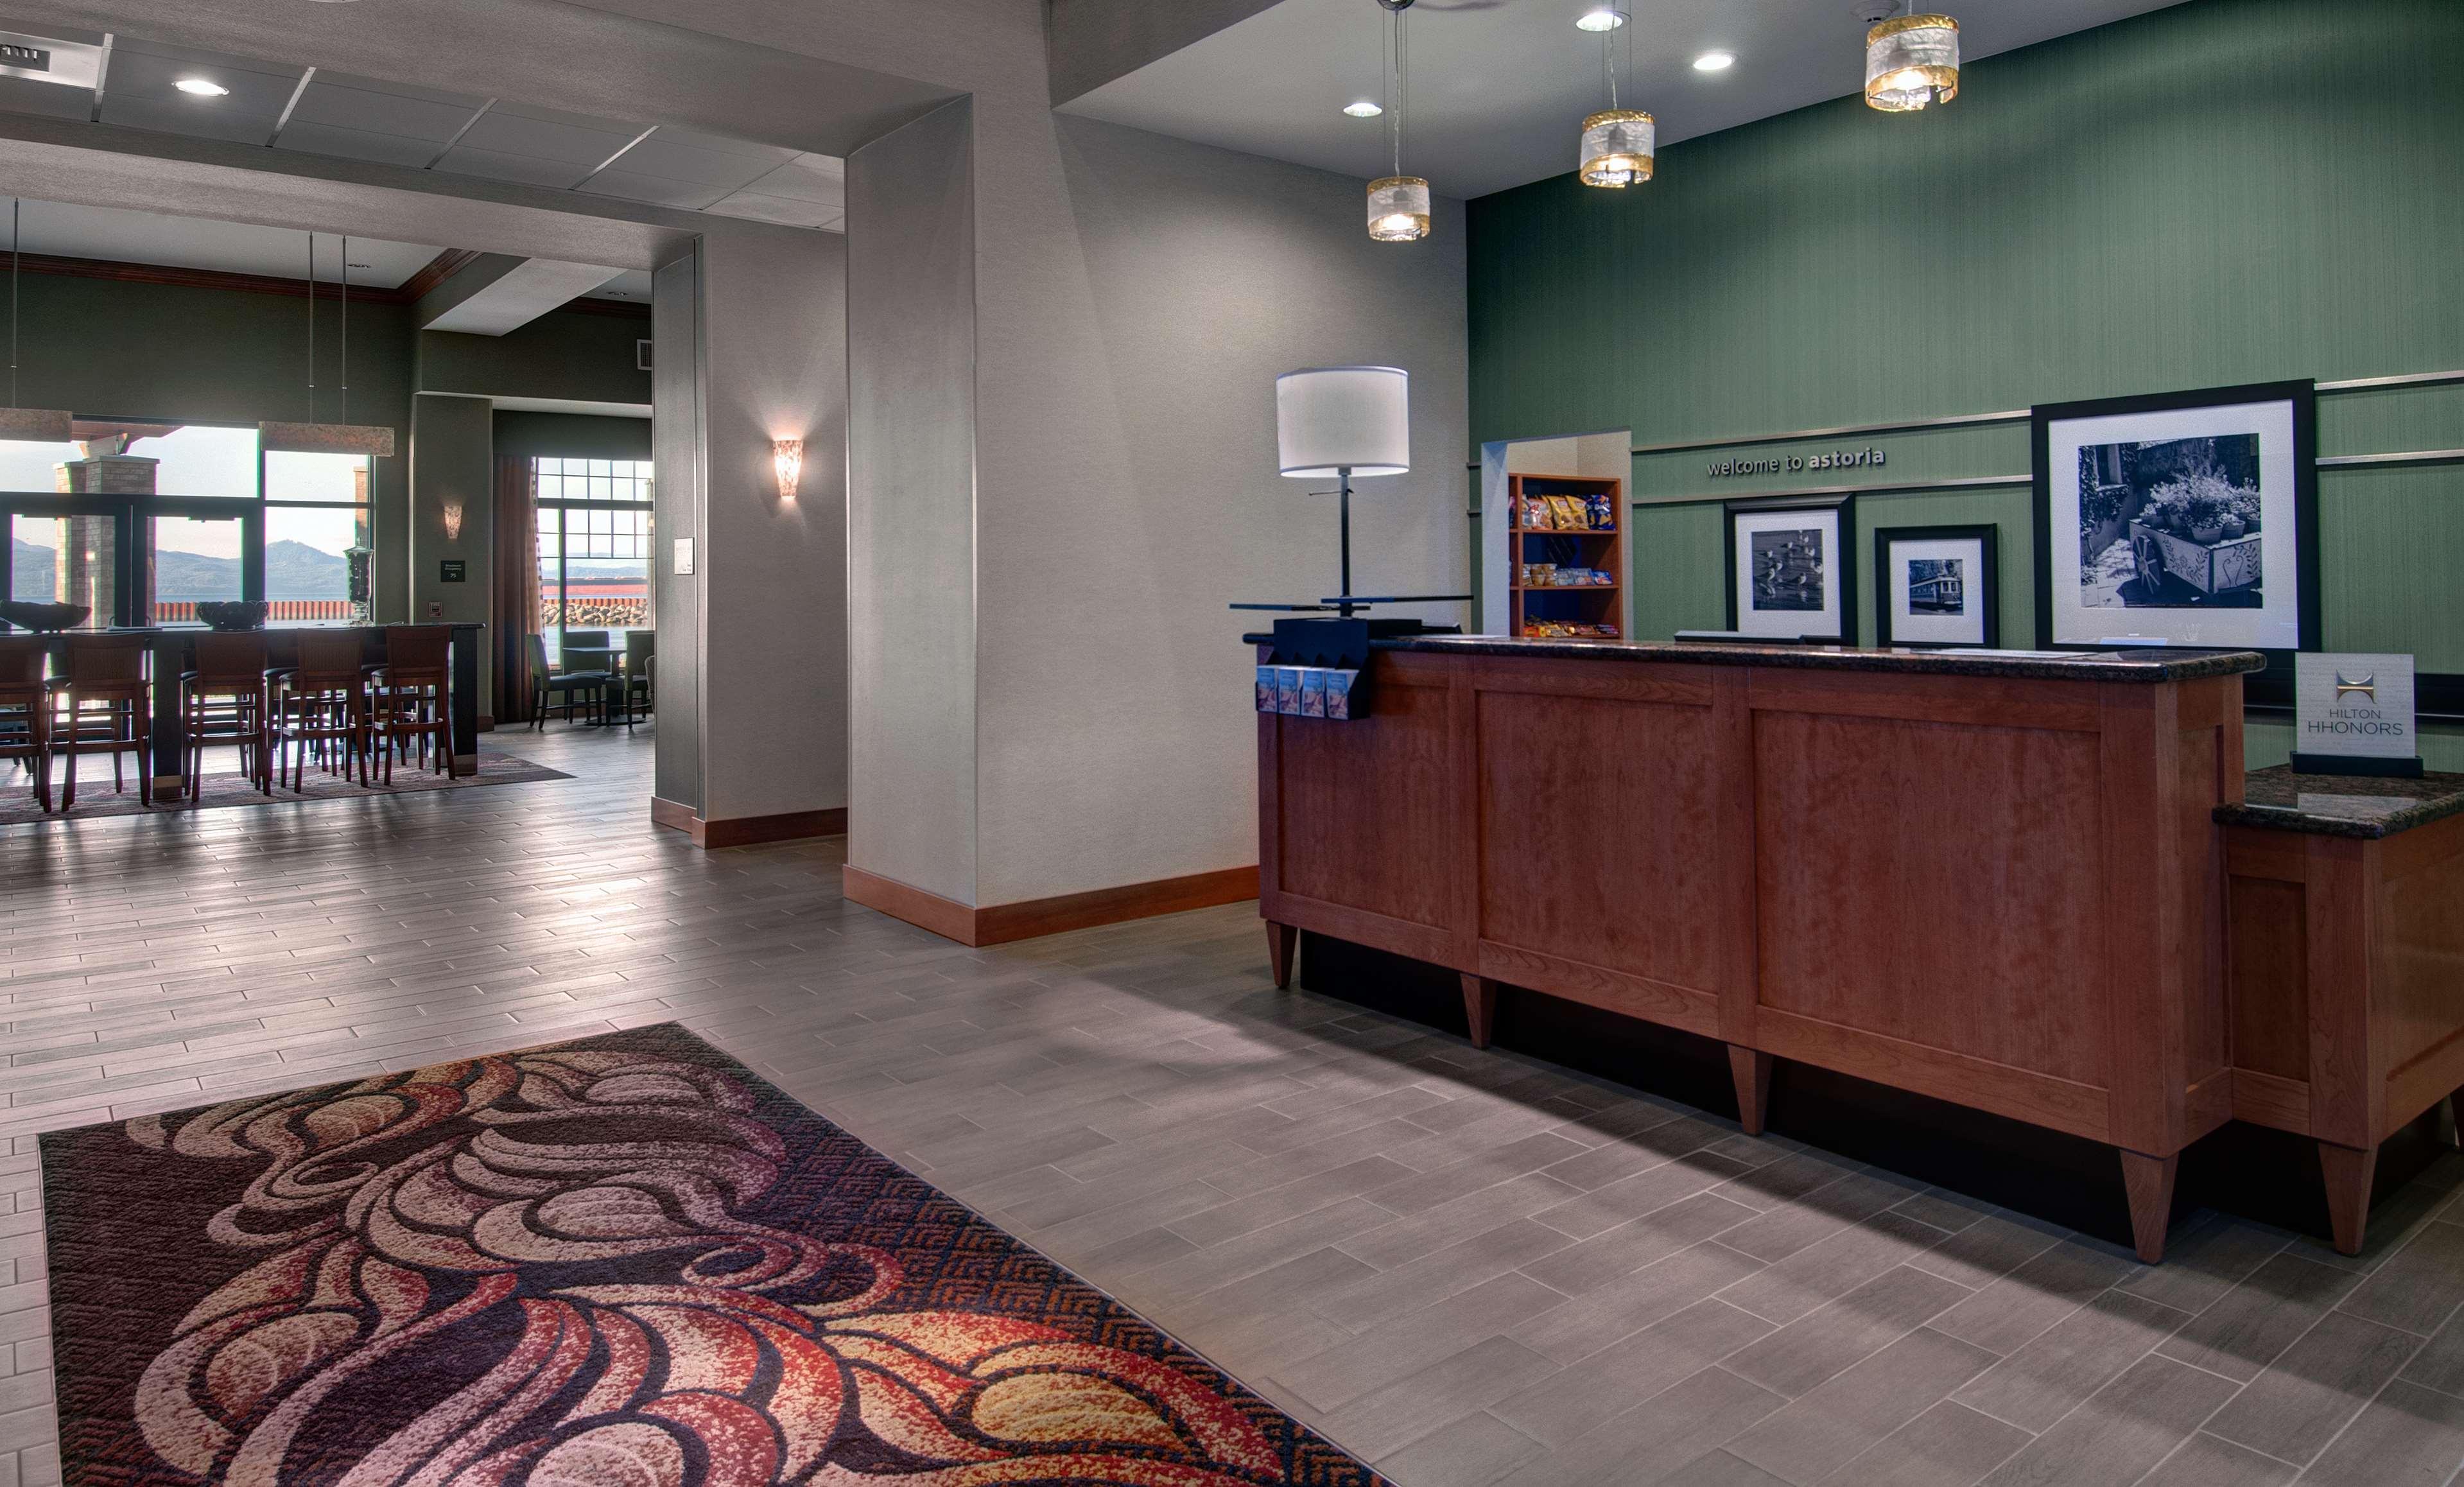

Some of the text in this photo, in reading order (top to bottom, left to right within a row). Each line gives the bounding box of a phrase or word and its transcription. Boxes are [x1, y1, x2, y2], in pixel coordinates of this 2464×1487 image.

[1708, 447, 1885, 476] welcome to astoria
[2329, 708, 2381, 719] HILTON
[2308, 721, 2403, 736] HHONORS
